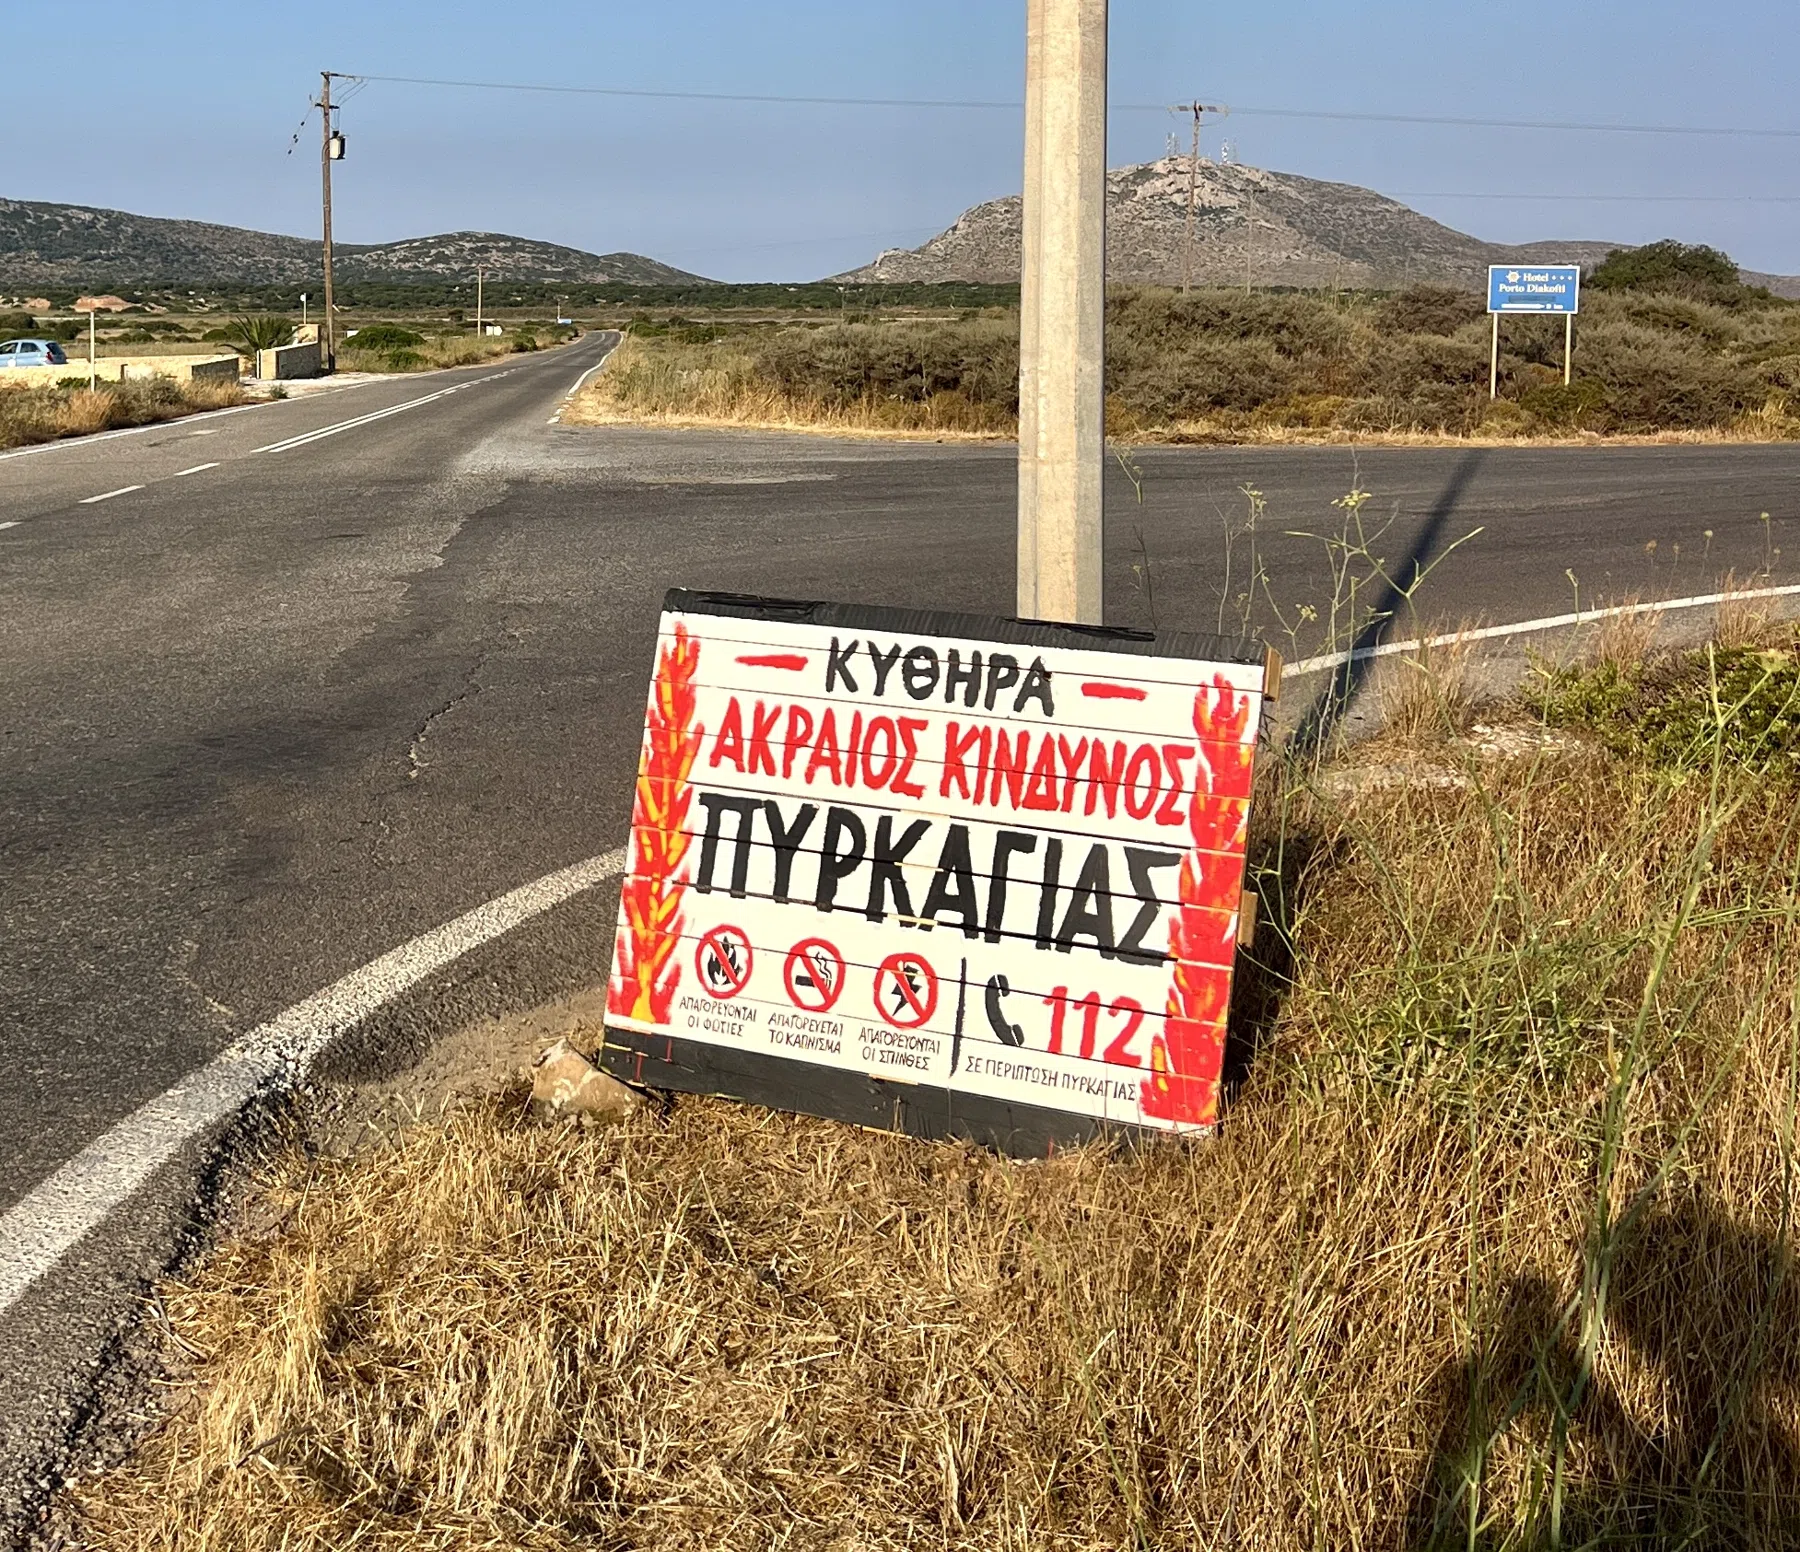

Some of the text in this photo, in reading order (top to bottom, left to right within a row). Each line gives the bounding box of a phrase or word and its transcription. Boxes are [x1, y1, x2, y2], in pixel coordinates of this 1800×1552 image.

[1499, 284, 1525, 292] Porto
[1523, 273, 1549, 282] Hotel
[825, 637, 1055, 717] ΚΥΘΗΡΑ
[709, 697, 1196, 826] ΑΚΡΑΙΟΣ ΚΙΝΔΥΝΟΣ
[696, 793, 1183, 967] ΠΥΡΚΑΓΙΑΣ
[679, 997, 758, 1022] ΑΠΑΓΟΡΕΥΟΝΤΑΙ
[687, 1015, 700, 1028] ΟΙ
[768, 1012, 844, 1036] ΑΠΑΓΟΡΕΥΕΤΑΙ
[1043, 986, 1143, 1067] 112
[769, 1030, 841, 1054] ΤΟ ΚΑΠΝΙΣΜΑ
[858, 1027, 941, 1054] ΑΠΑΓΟΡΕΥΟΝΤΑΙ
[862, 1046, 877, 1061] ΟΙ
[965, 1055, 1138, 1101] ΣΕ ΠΕΡΙΠΤΩΣΗ ΠΥΡΚΑΓΙΑΣ
